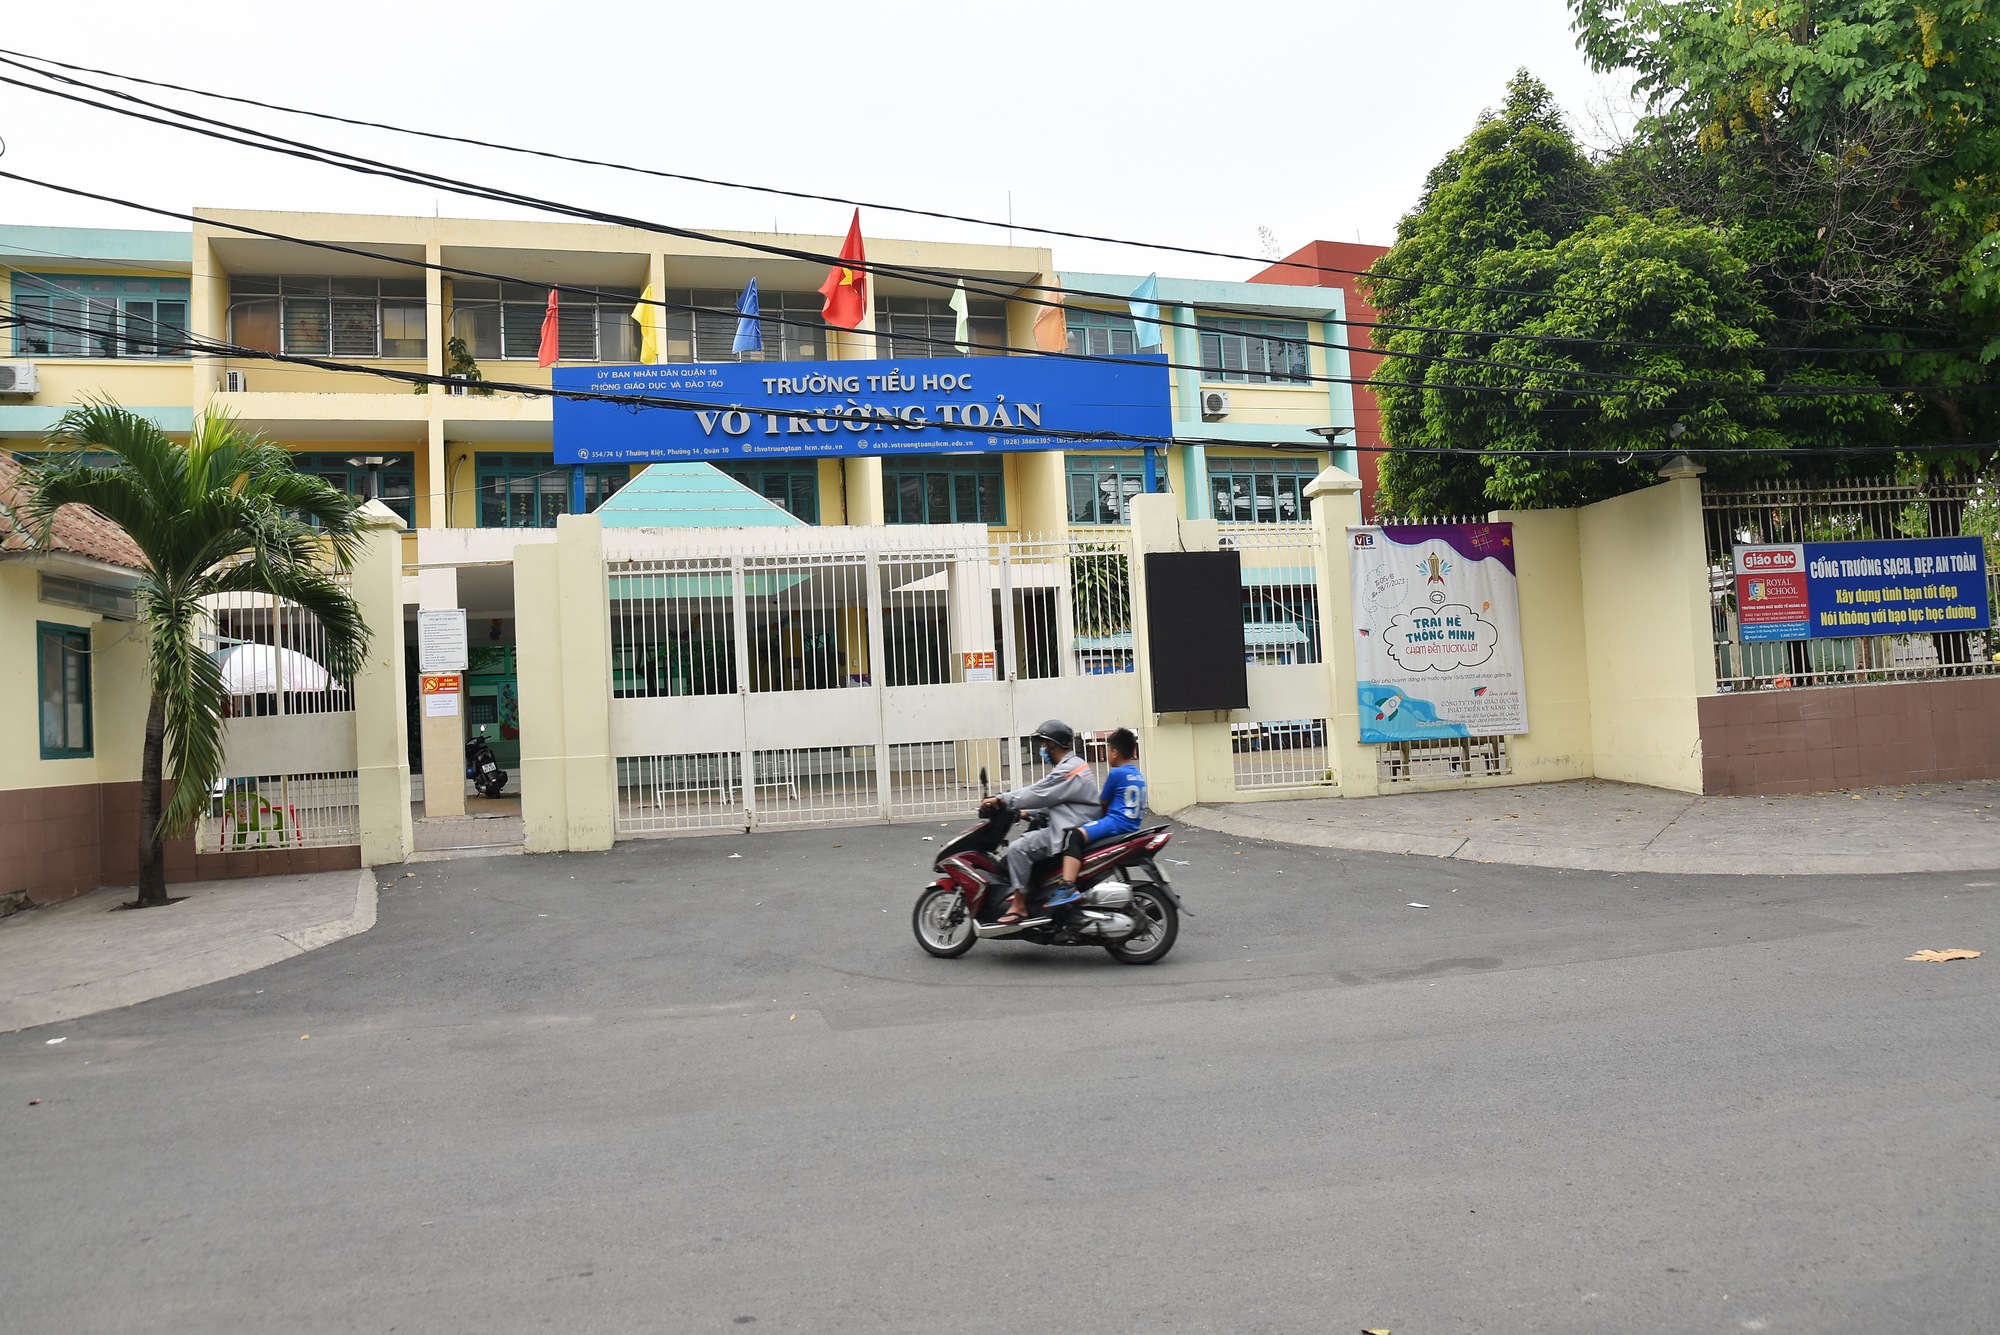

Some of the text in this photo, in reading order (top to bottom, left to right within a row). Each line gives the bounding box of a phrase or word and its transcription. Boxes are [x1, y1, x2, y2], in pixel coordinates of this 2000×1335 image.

[633, 369, 658, 378] NHÂN
[660, 369, 678, 377] DÂN
[680, 368, 706, 378] QUẬN
[591, 380, 724, 391] PHÒNG GIÁO DỤC VÀ ĐÀO TẠO
[762, 368, 972, 395] TRƯỜNG TIỂU HỌC
[695, 394, 1042, 436] VÕ TRƯỜNG TOẢN
[1745, 553, 1794, 568] giáo dục
[1810, 552, 1977, 579] CỔNG TRƯỜNG SẠCH, ĐẸP, AN TOÀN
[1766, 587, 1798, 596] SCHOOL
[1836, 584, 1958, 605] Xây dựng tình bạn tốt đẹp
[1413, 614, 1462, 629] TRẠI HÈ
[1820, 611, 1837, 626] Nói
[1838, 610, 1870, 626] không
[1871, 608, 1887, 623] với
[1888, 609, 1908, 625] bạo
[1908, 607, 1924, 624] lực
[1925, 606, 1944, 623] học
[1945, 604, 1977, 621] đường
[1406, 629, 1475, 643] THÔNG MINH
[1406, 644, 1426, 655] CHẠM
[1428, 642, 1440, 654] ĐẾN
